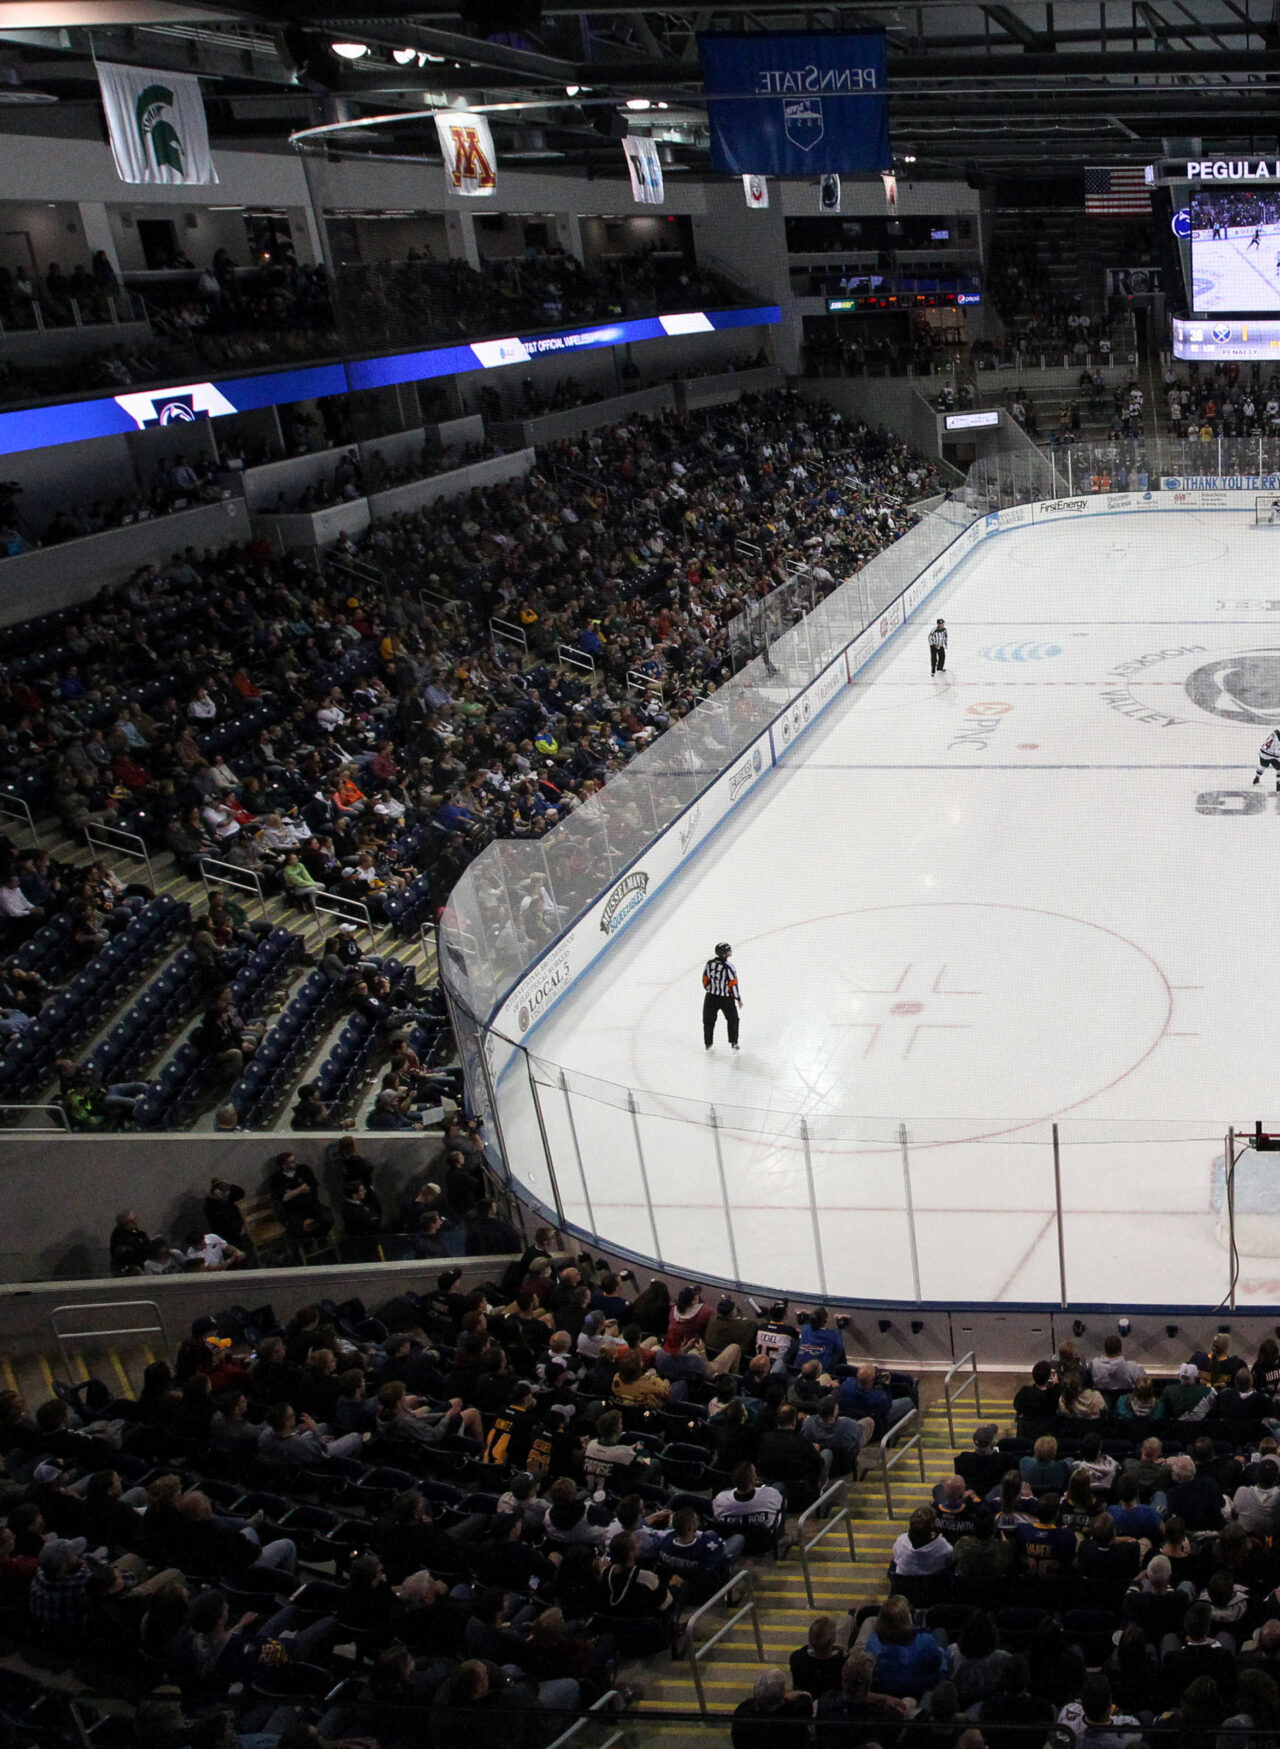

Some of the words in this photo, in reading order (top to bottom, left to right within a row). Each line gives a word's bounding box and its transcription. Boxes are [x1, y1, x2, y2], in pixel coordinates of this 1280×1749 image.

[1187, 161, 1270, 180] PEGULA
[538, 339, 564, 351] OFFICIAL
[1184, 477, 1218, 490] THANK
[1221, 477, 1242, 489] YOU
[1040, 500, 1087, 513] FirstEnergy
[1108, 645, 1206, 678] HOCKEY
[1099, 688, 1190, 728] VALLEY
[947, 718, 1002, 751] PNC
[528, 971, 564, 1012] LOCAL
[563, 961, 570, 976] 5
[584, 1458, 615, 1477] PARISE
